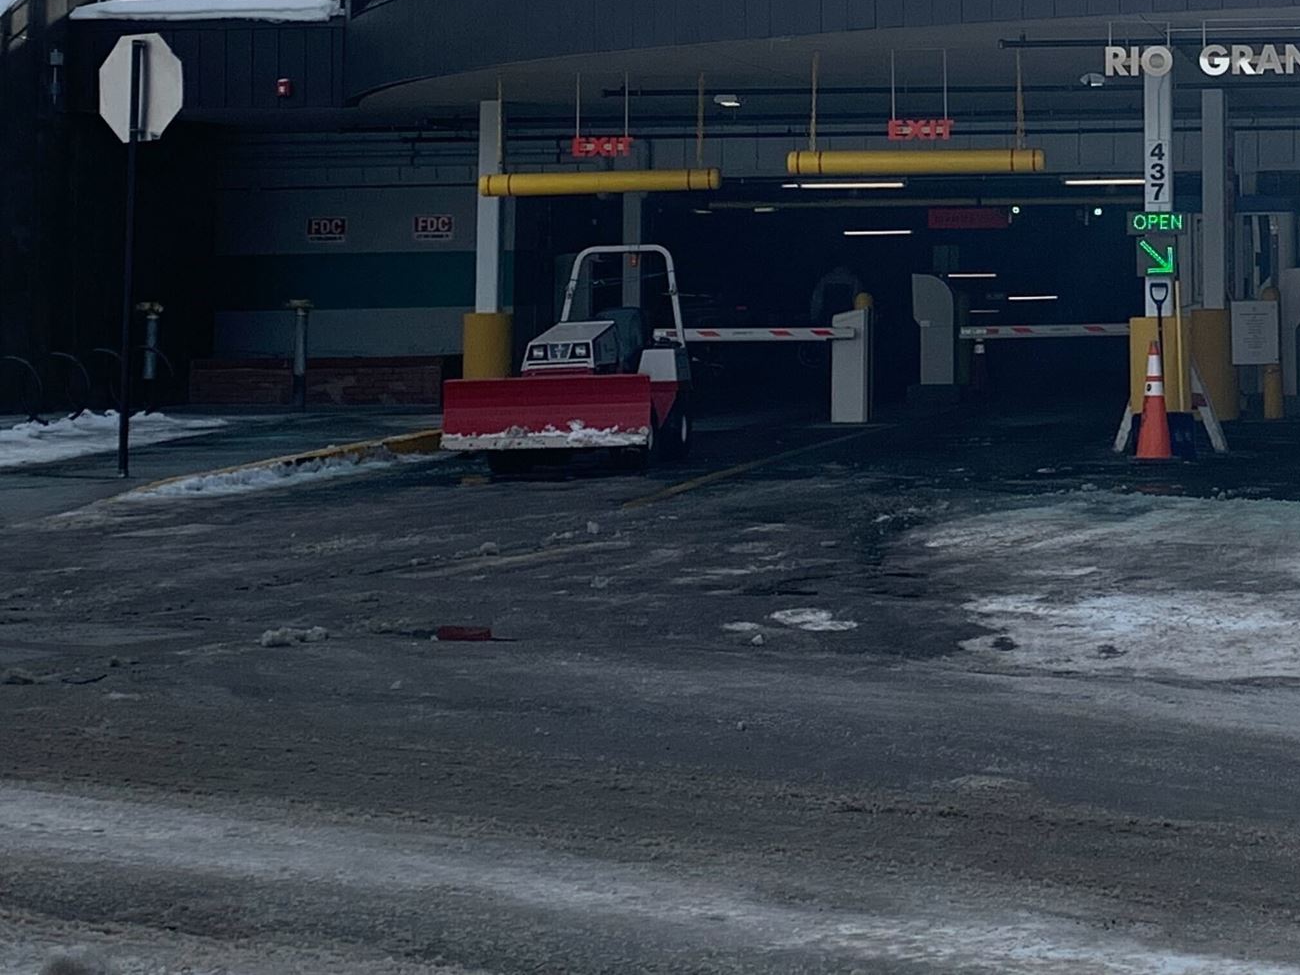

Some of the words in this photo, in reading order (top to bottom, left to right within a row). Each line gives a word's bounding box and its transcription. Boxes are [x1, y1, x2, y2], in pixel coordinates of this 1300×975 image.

[1105, 46, 1173, 76] RIO
[887, 119, 954, 140] EXIT
[572, 137, 634, 157] EXIT
[1150, 143, 1165, 201] 437
[311, 219, 343, 234] FDC
[417, 217, 450, 231] FDC
[1133, 214, 1183, 230] OPEN
